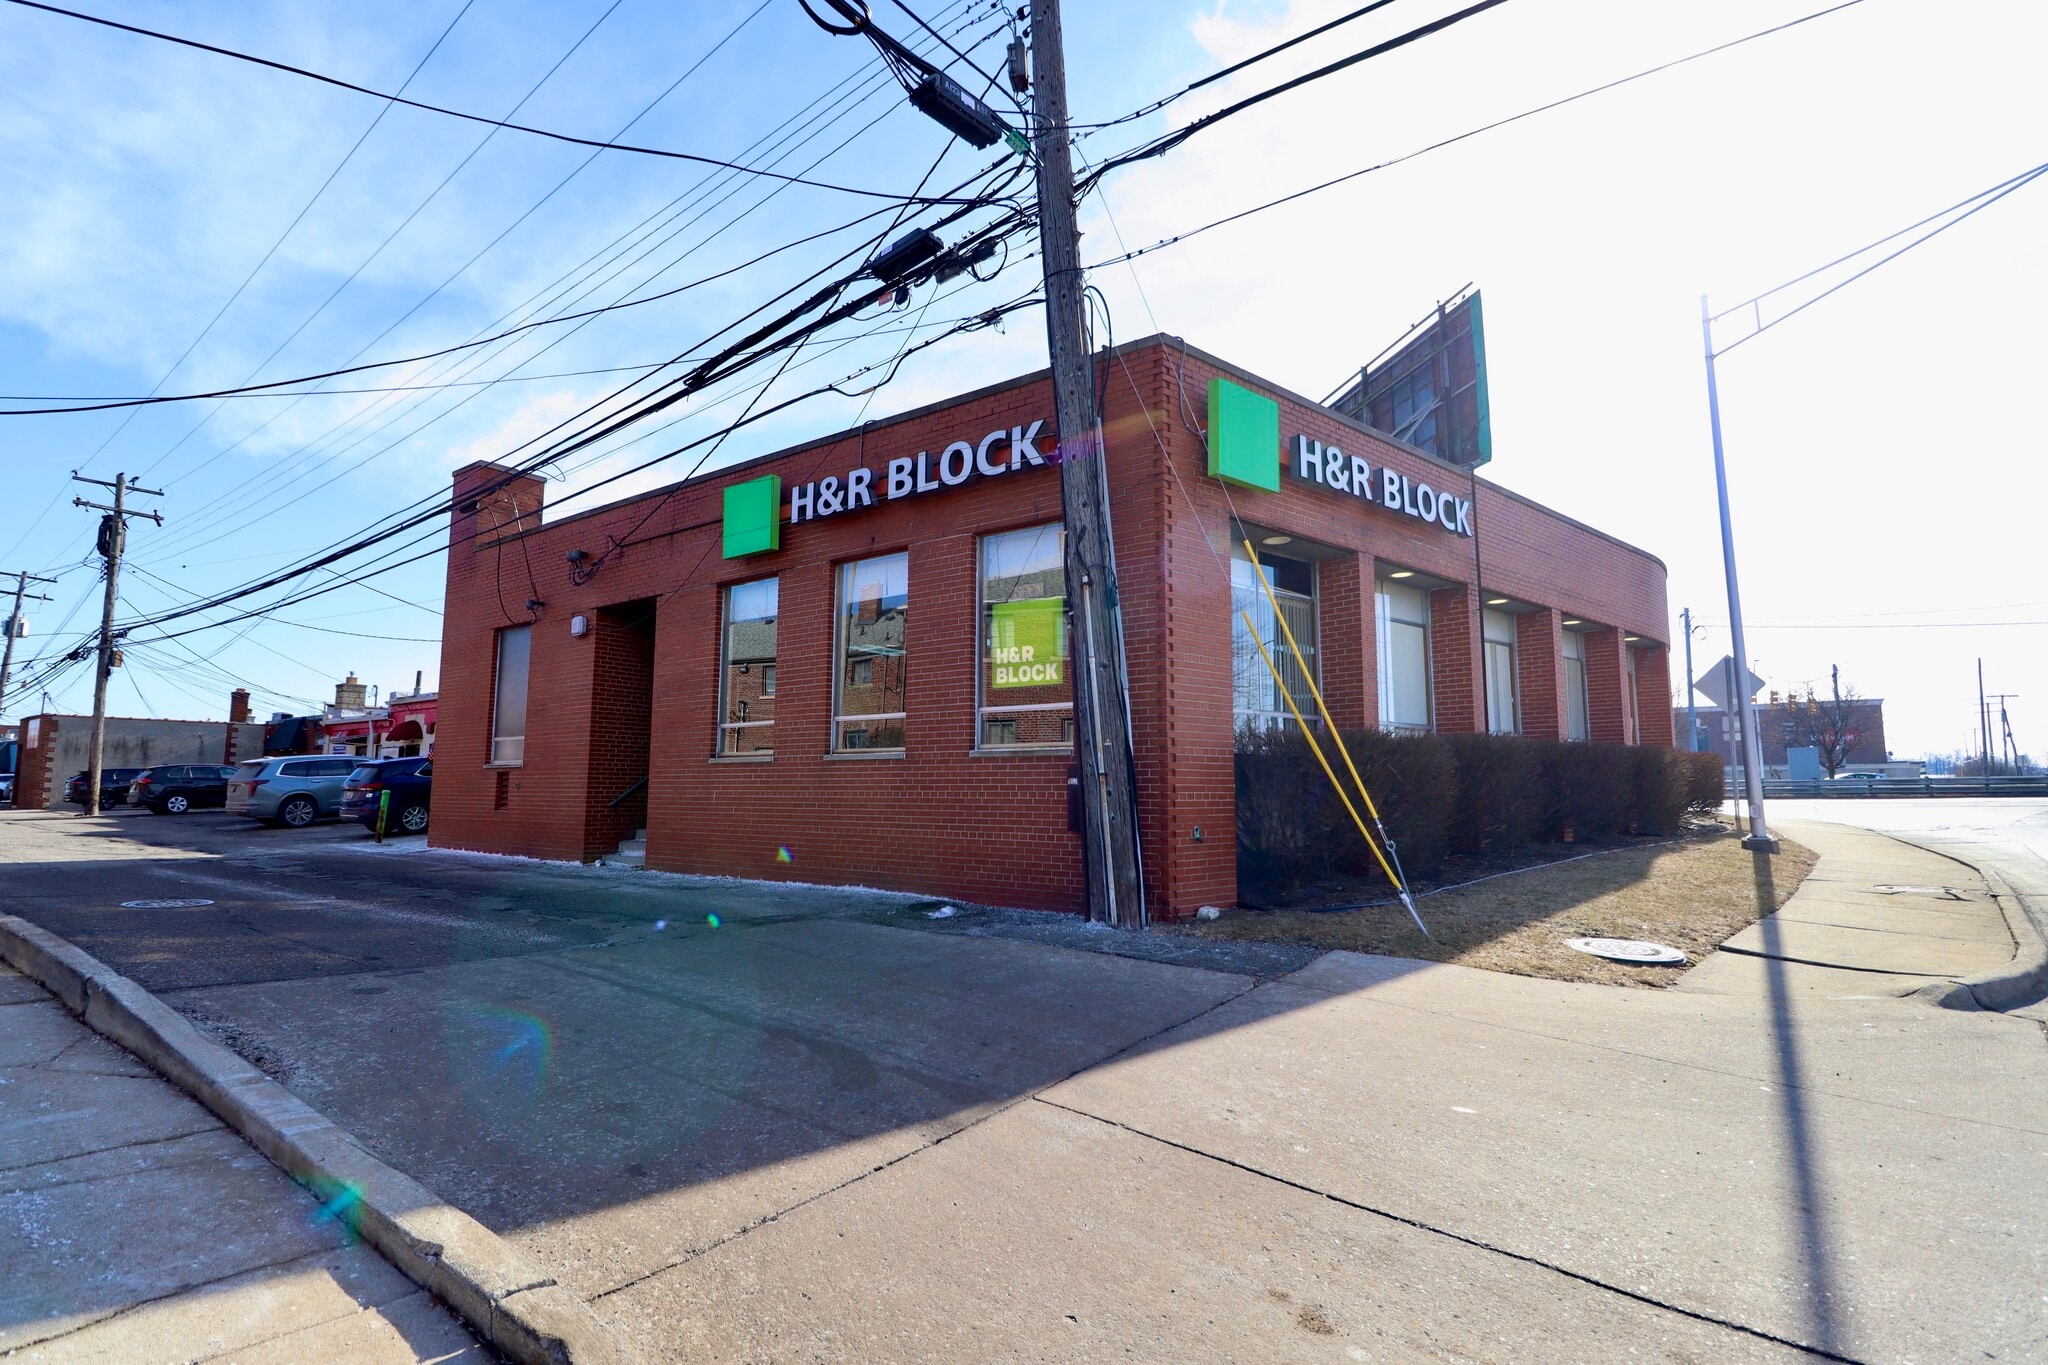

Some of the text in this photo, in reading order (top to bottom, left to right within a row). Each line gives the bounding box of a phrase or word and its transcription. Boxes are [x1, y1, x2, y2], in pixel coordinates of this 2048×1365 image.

[790, 418, 1049, 524] H&R BLOCK
[1298, 434, 1473, 537] H&R BLOCK
[995, 645, 1035, 664] H&R
[995, 662, 1058, 684] BLOCK
